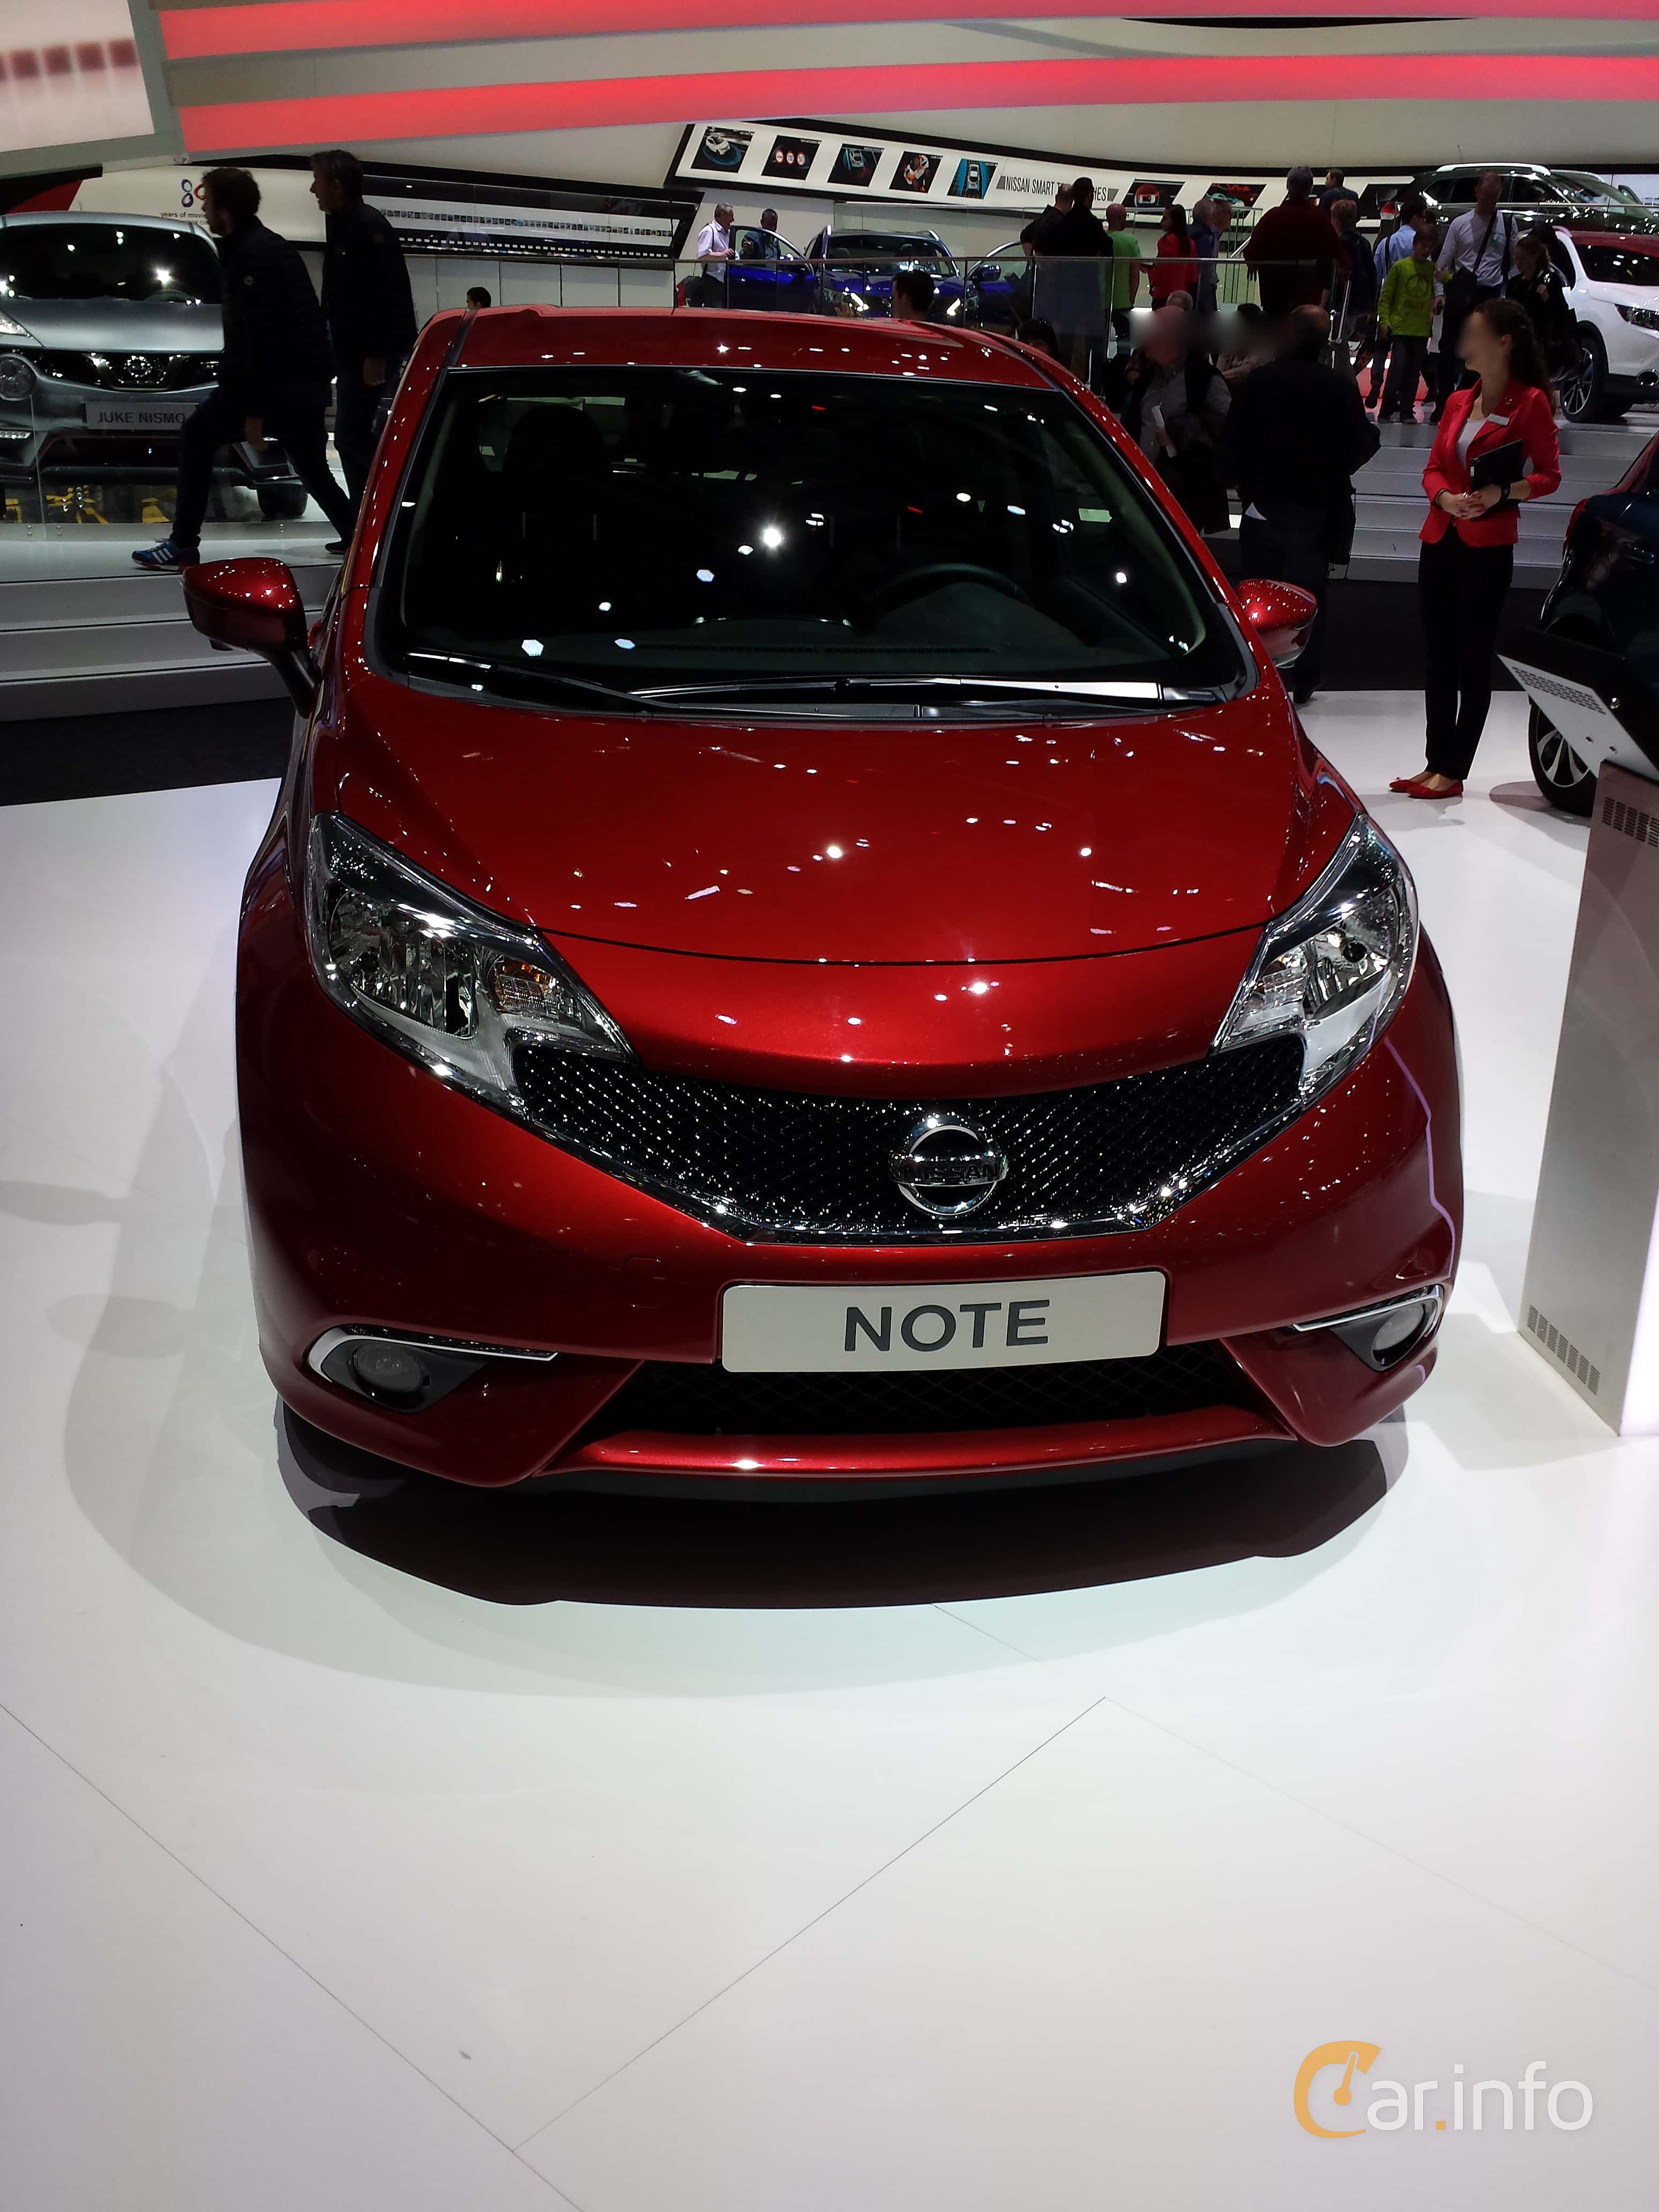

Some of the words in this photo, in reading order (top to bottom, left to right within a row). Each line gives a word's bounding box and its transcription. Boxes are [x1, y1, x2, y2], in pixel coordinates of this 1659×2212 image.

[1006, 176, 1030, 193] NISSAN
[1032, 179, 1055, 196] SMART
[98, 411, 133, 423] JUKE
[138, 412, 186, 424] NISMO
[844, 1299, 1051, 1352] NOTE
